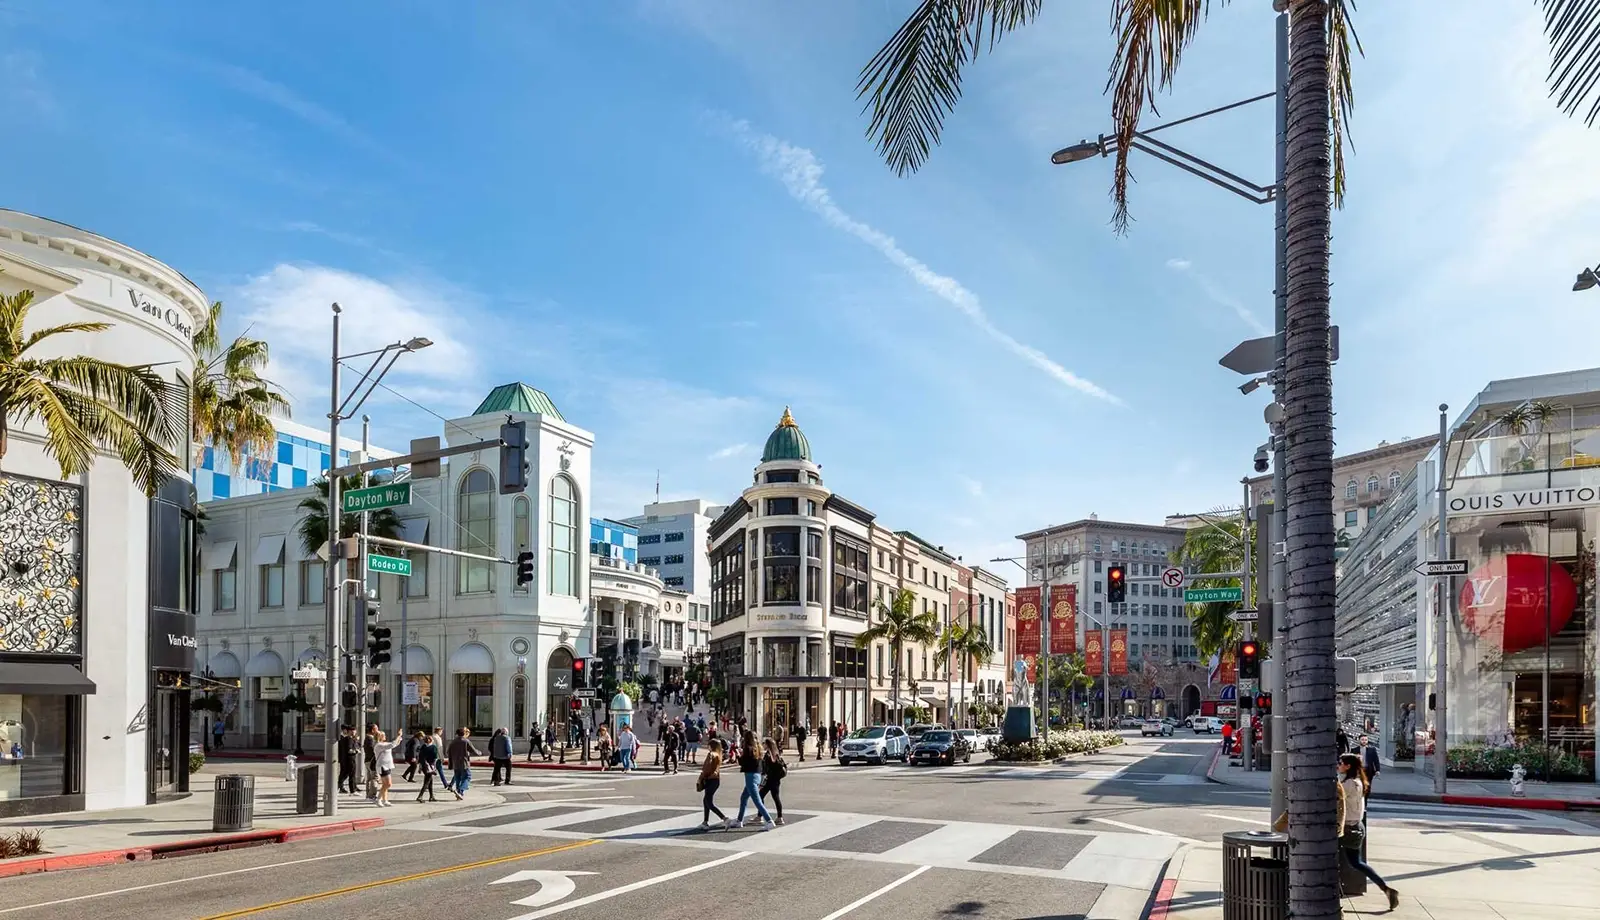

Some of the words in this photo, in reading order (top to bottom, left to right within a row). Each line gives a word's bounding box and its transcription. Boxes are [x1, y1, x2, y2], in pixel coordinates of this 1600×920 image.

[127, 288, 161, 319] Van
[348, 493, 382, 508] Dayton
[386, 489, 405, 502] Way
[1447, 495, 1503, 512] OUIS
[1513, 487, 1600, 507] VUITTO
[371, 559, 396, 570] Rodeo
[398, 562, 408, 571] Dr
[1188, 592, 1219, 600] Dayton
[1220, 591, 1238, 599] Way
[168, 633, 181, 646] Van
